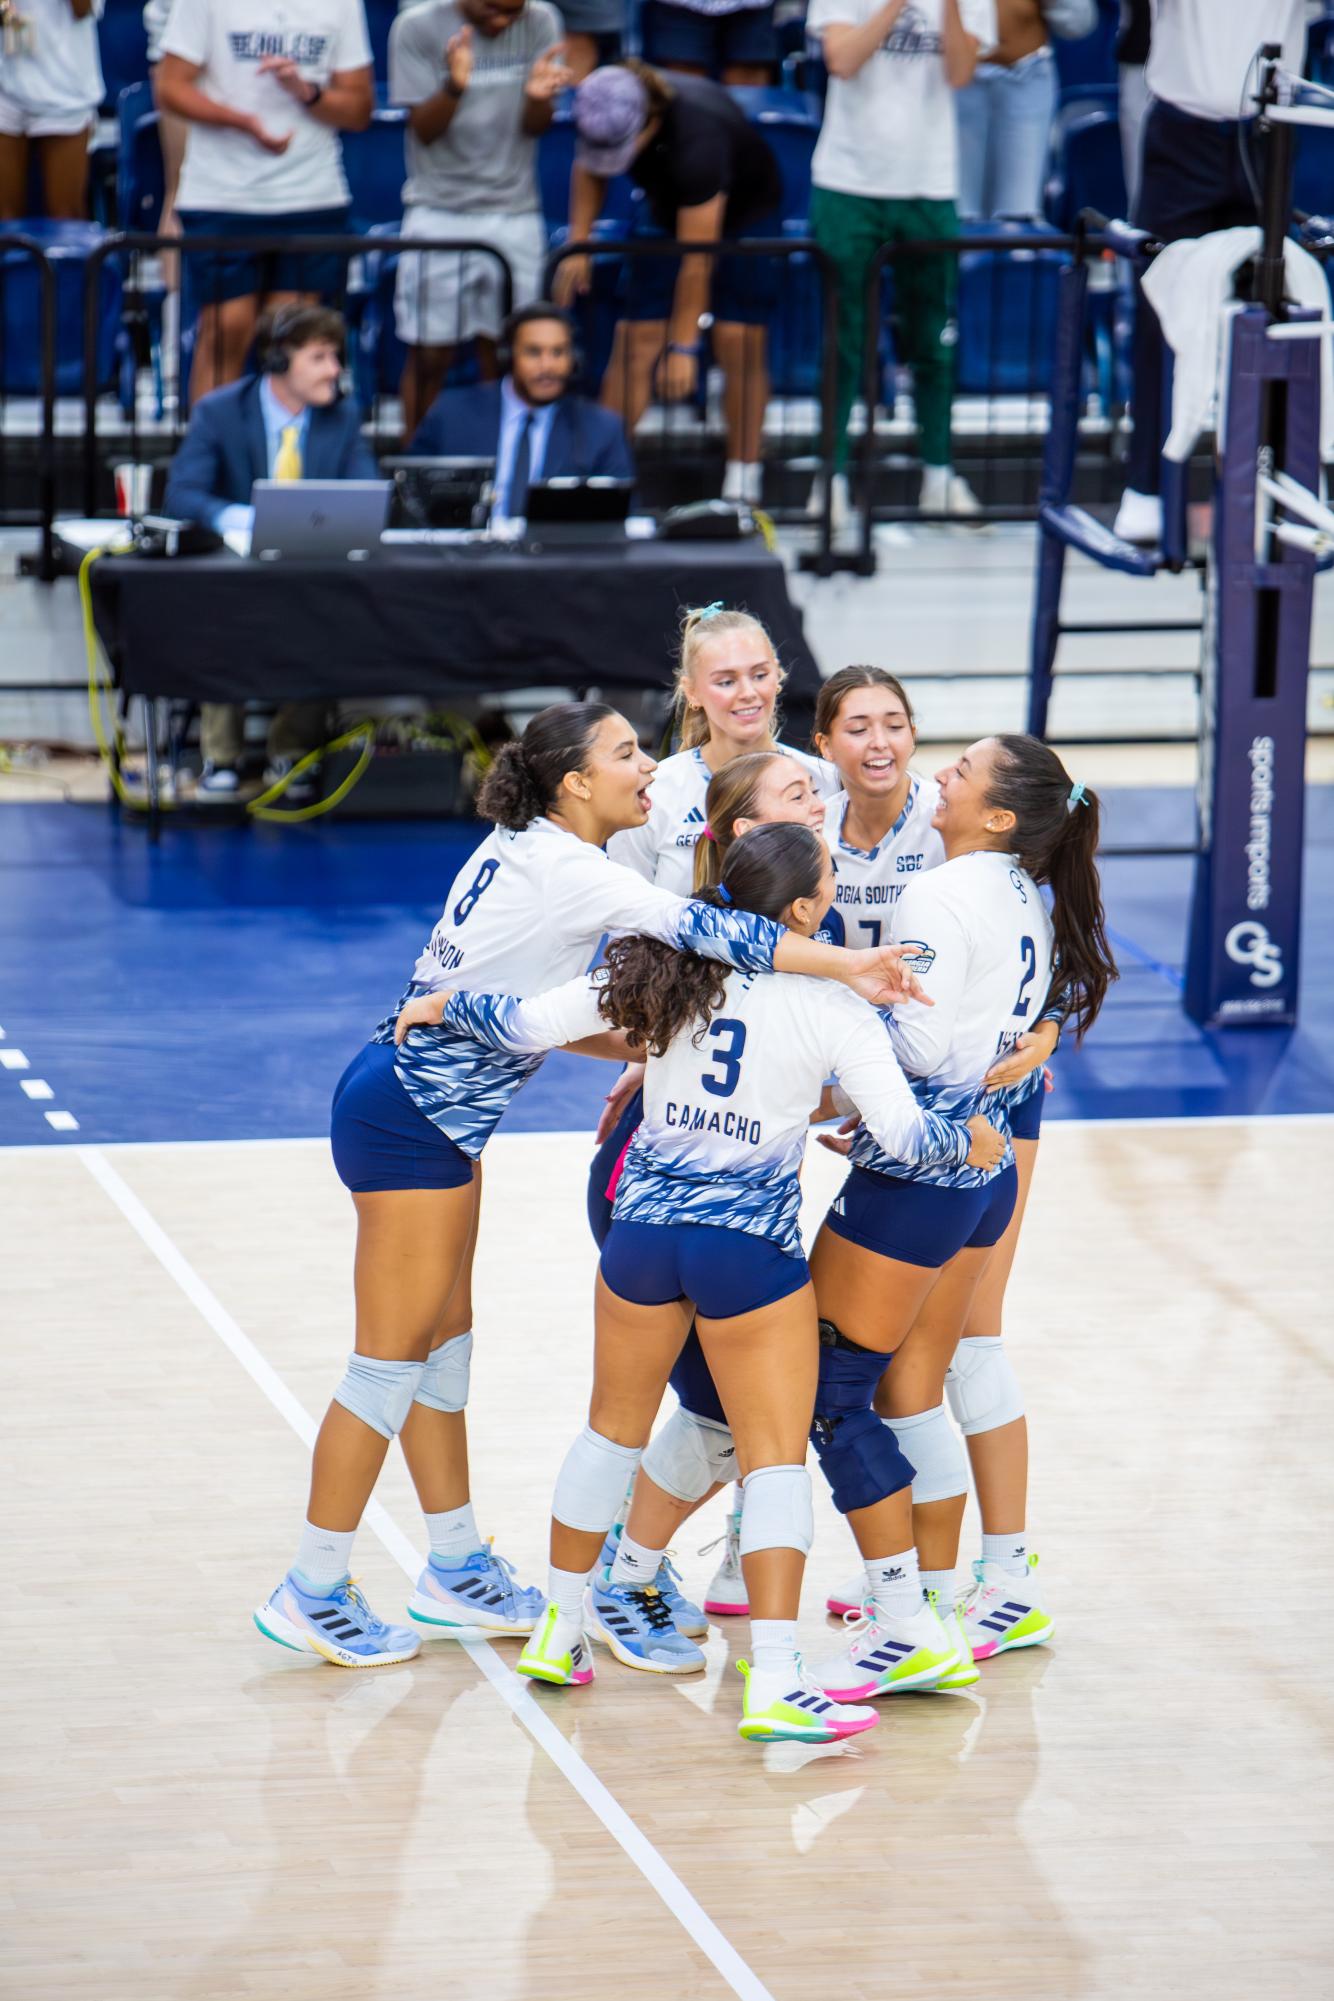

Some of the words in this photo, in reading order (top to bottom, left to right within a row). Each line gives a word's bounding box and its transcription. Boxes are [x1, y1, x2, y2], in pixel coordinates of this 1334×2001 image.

[1248, 736, 1274, 814] sports
[454, 858, 501, 927] 8
[833, 884, 862, 905] RGIA
[896, 853, 924, 872] SBC
[1244, 815, 1271, 910] imports
[858, 920, 881, 948] 7
[1012, 936, 1037, 1017] 2
[701, 1018, 747, 1097] 3
[666, 1101, 761, 1146] CAMACHO
